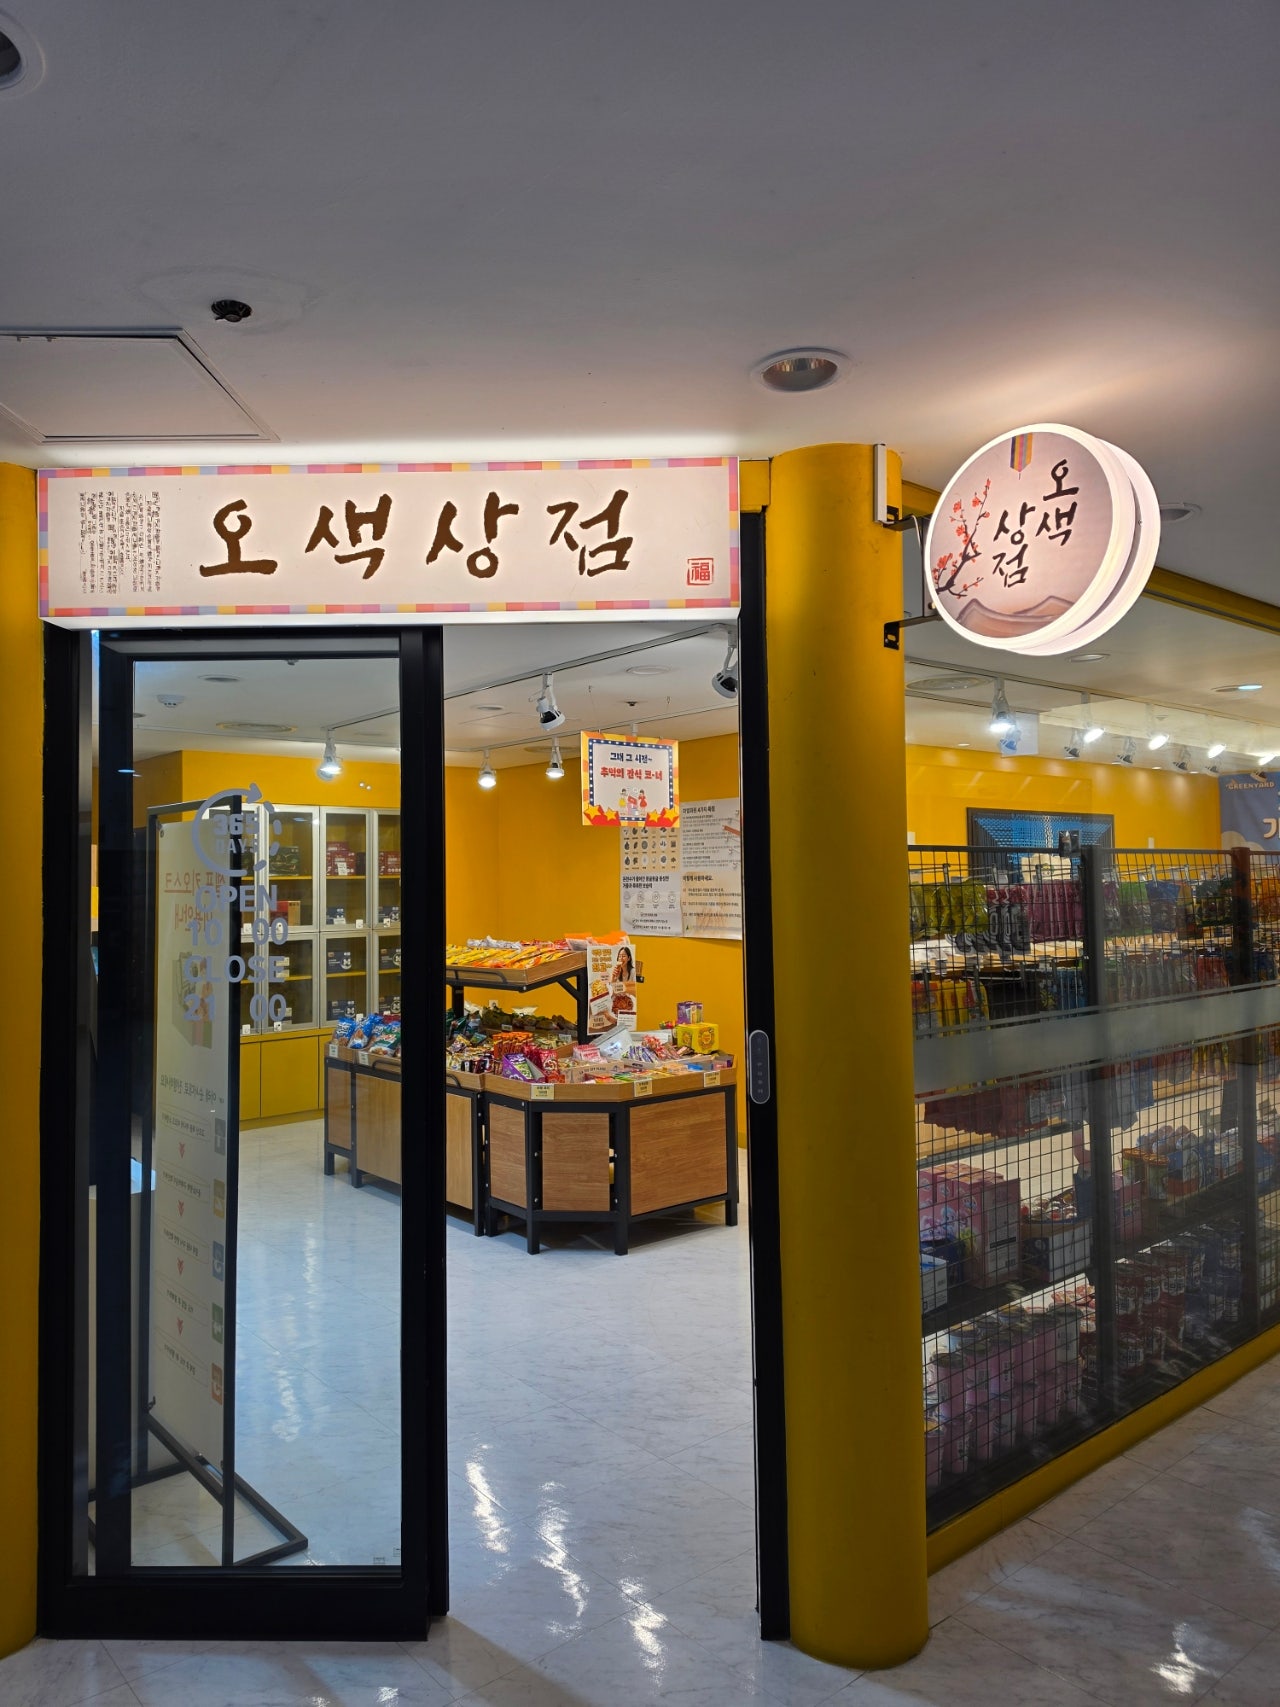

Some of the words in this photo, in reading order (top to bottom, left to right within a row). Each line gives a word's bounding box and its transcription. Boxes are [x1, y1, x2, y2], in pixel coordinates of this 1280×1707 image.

[690, 561, 711, 582] 福
[626, 753, 633, 762] 그
[600, 766, 624, 779] 추억의
[627, 768, 643, 780] 간식
[212, 813, 259, 835] 365
[215, 838, 258, 854] DAYS
[195, 884, 278, 913] OPEN
[183, 955, 286, 983] CLOSE
